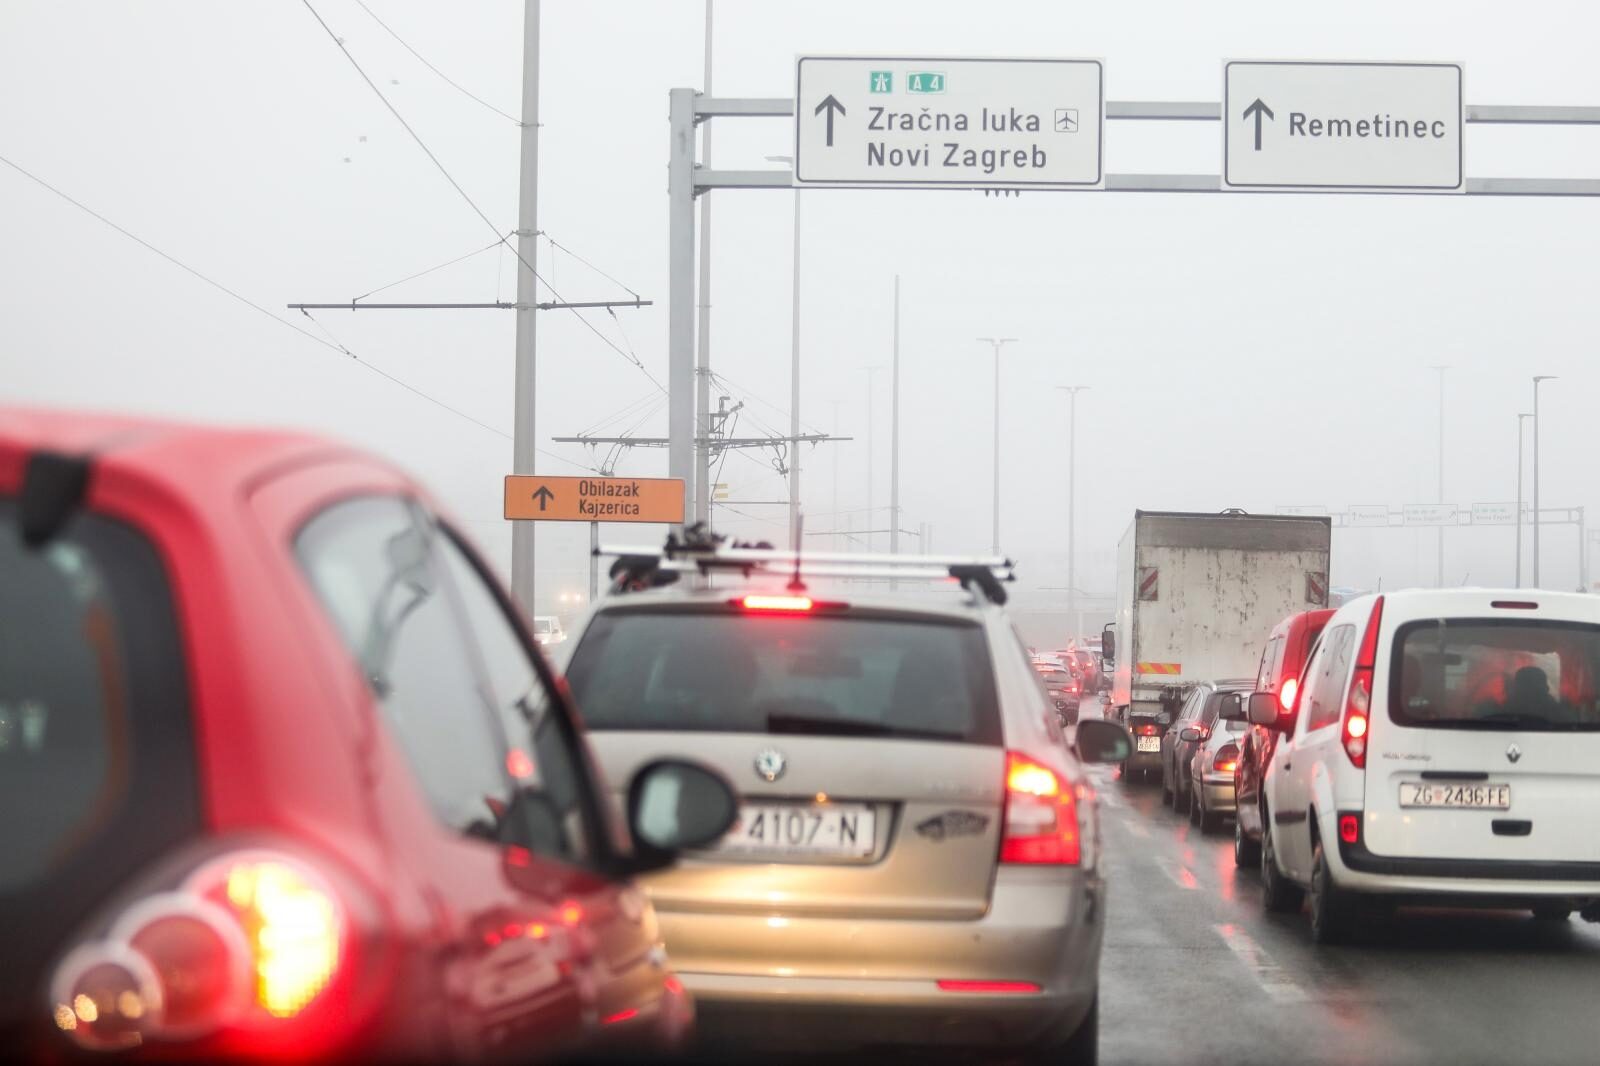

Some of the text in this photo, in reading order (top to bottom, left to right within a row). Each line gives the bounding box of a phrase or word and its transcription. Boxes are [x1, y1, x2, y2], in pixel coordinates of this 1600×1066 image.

[868, 107, 1040, 132] Zračna luka
[1289, 112, 1445, 138] Remetinec
[868, 142, 1047, 174] Novi Zagreb
[579, 480, 639, 497] Obilazak
[579, 499, 639, 518] Kajzerica
[1413, 784, 1432, 804] ZG
